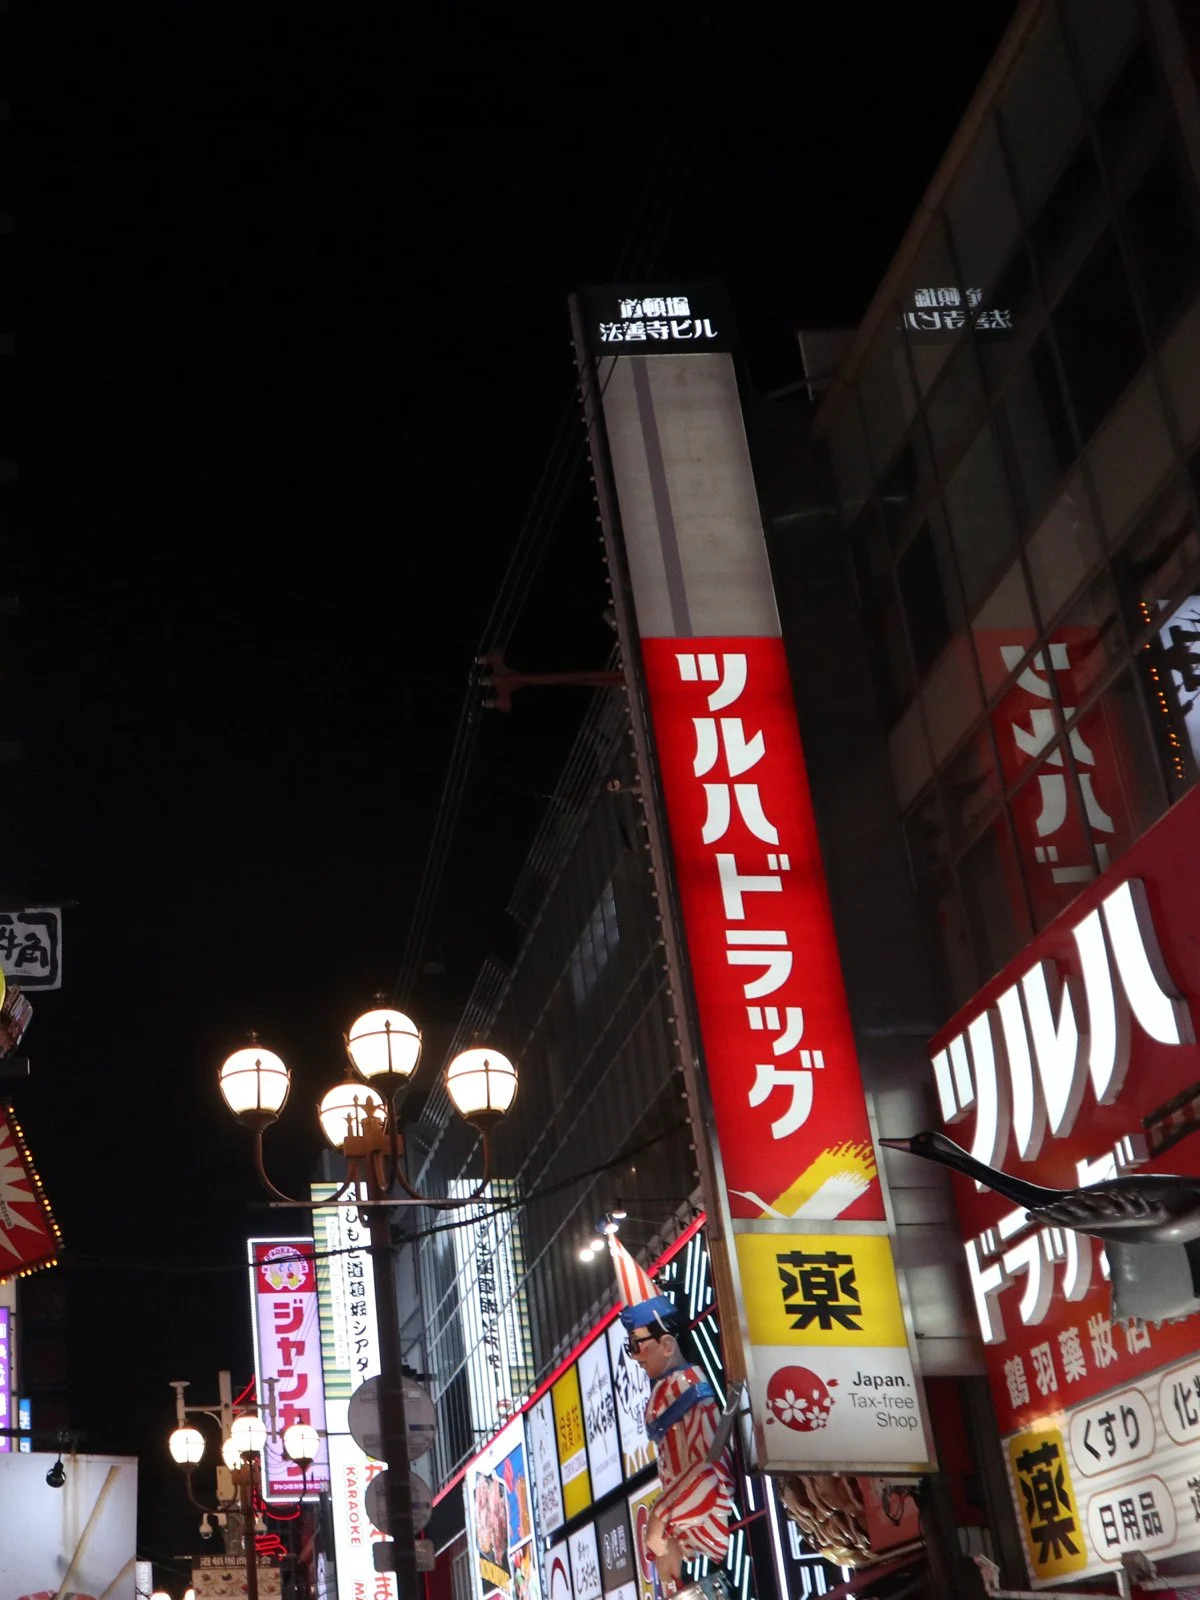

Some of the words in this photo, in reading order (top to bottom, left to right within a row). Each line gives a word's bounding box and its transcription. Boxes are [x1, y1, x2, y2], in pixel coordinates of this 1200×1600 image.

[599, 318, 718, 342] 法善寺ビル
[675, 653, 826, 1140] ツルハドラッグ
[931, 878, 1182, 1192] ツルハ
[776, 1250, 863, 1332] 薬
[847, 1393, 915, 1409] Tax-free
[852, 1371, 911, 1390] Japan.
[876, 1412, 919, 1431] Shop
[1082, 1405, 1141, 1461] くすり
[346, 1466, 361, 1544] KARAOKE
[1016, 1441, 1081, 1565] 薬
[1099, 1491, 1164, 1548] 日用品
